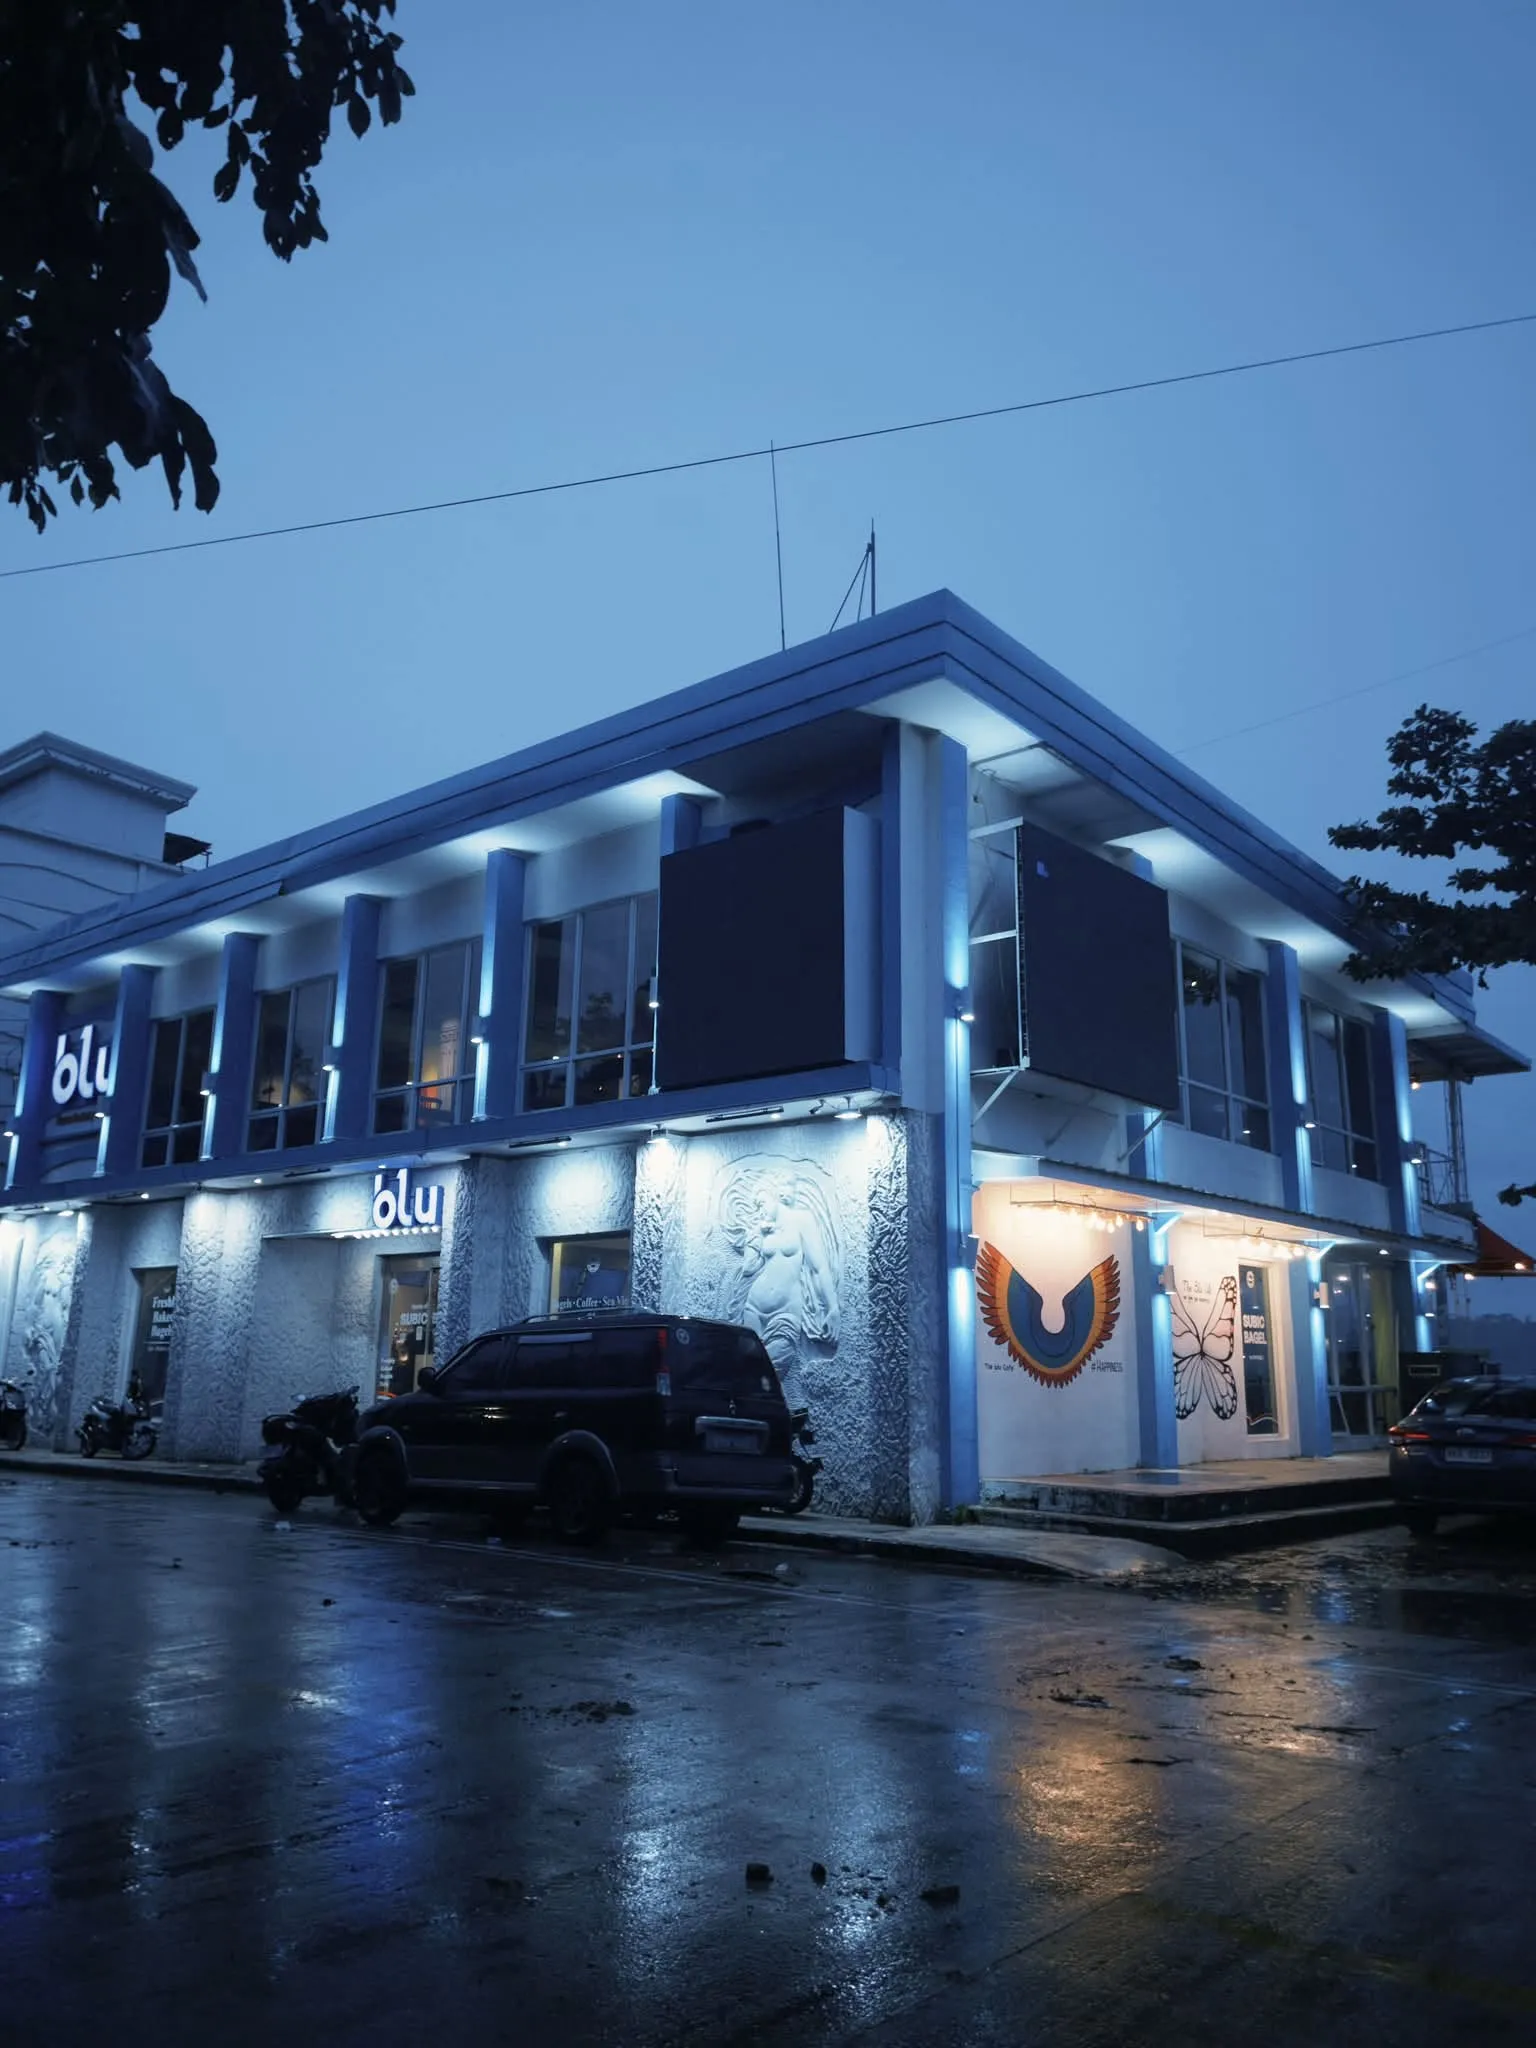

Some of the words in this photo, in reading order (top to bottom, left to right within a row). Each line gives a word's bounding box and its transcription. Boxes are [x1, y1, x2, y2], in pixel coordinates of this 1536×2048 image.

[373, 1168, 438, 1229] blu
[1243, 1314, 1264, 1328] SUBIC
[1244, 1331, 1267, 1345] BAGEL
